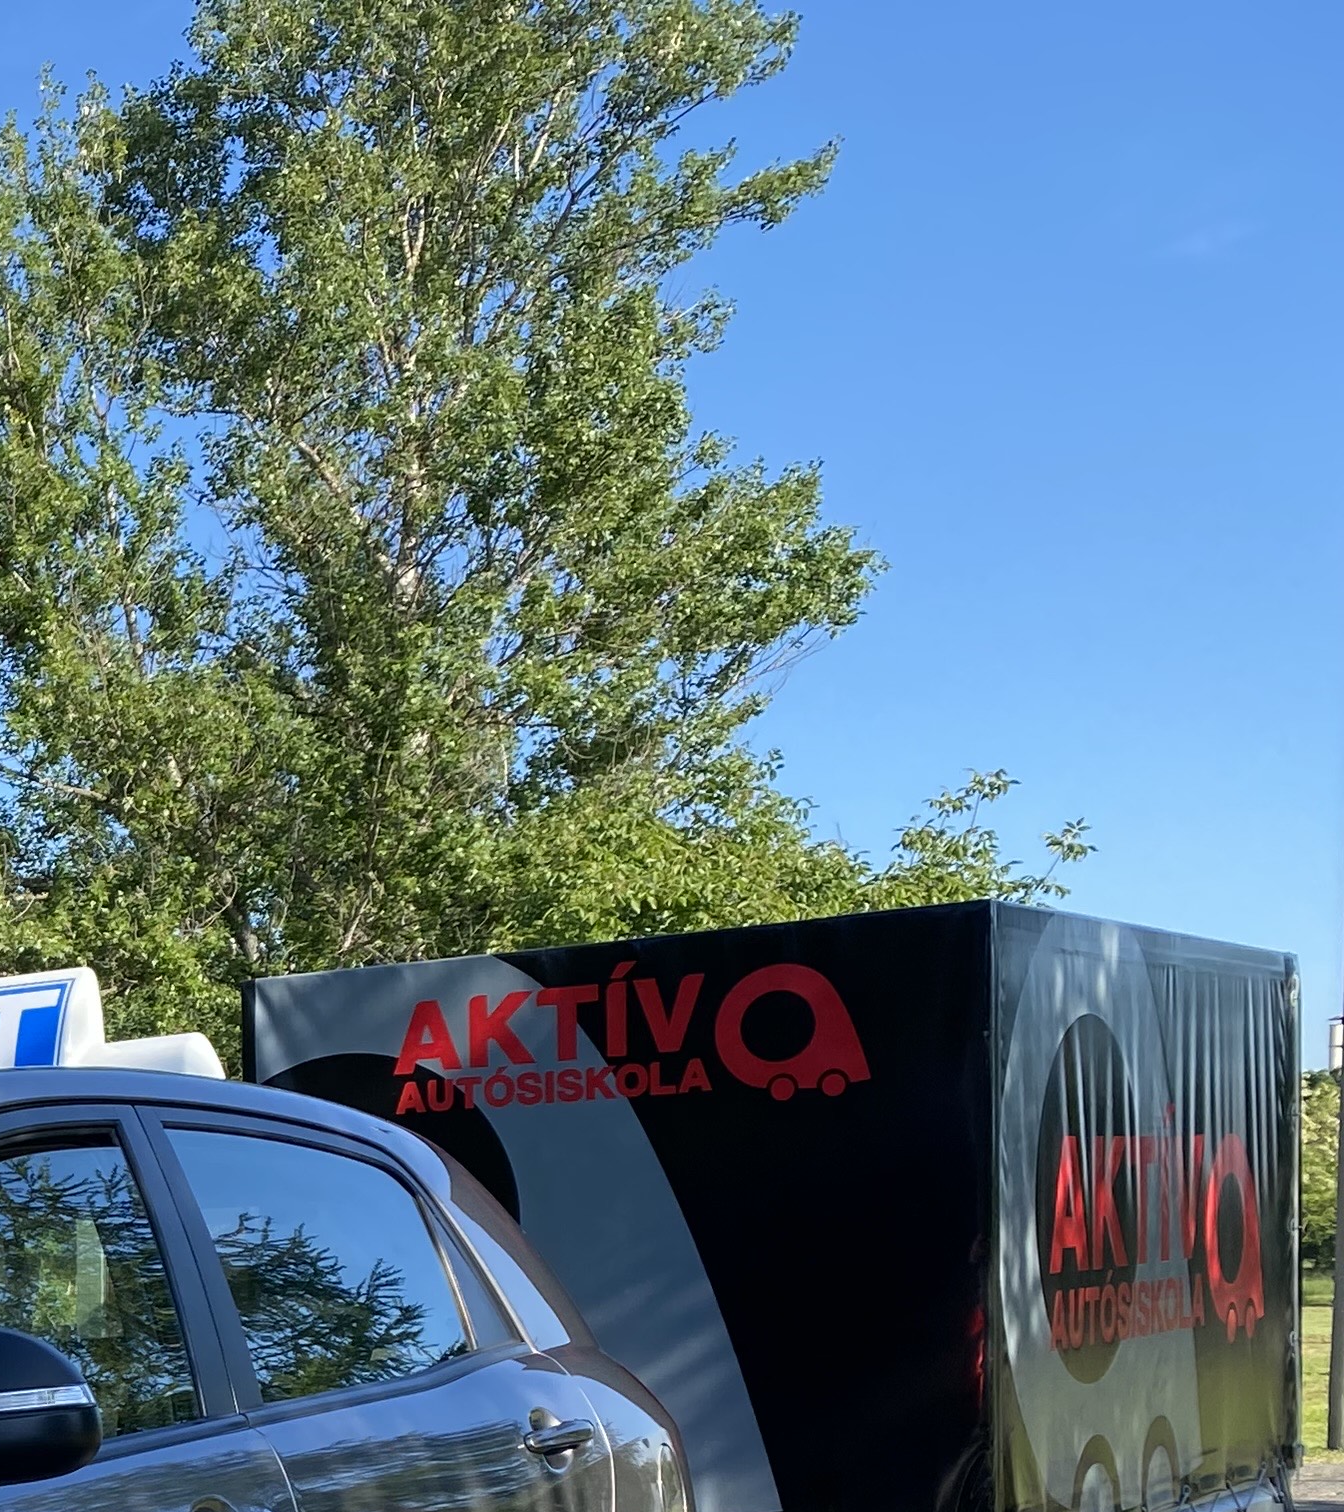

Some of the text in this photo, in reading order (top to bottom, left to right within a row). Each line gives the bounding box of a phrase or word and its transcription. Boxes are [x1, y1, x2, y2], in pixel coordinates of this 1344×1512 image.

[392, 961, 705, 1077] AKTÍV
[394, 1058, 713, 1117] AUTÓSISKOLA
[1048, 1101, 1206, 1276] AKTÍV
[1050, 1269, 1206, 1352] AUTÓSISKOLA
